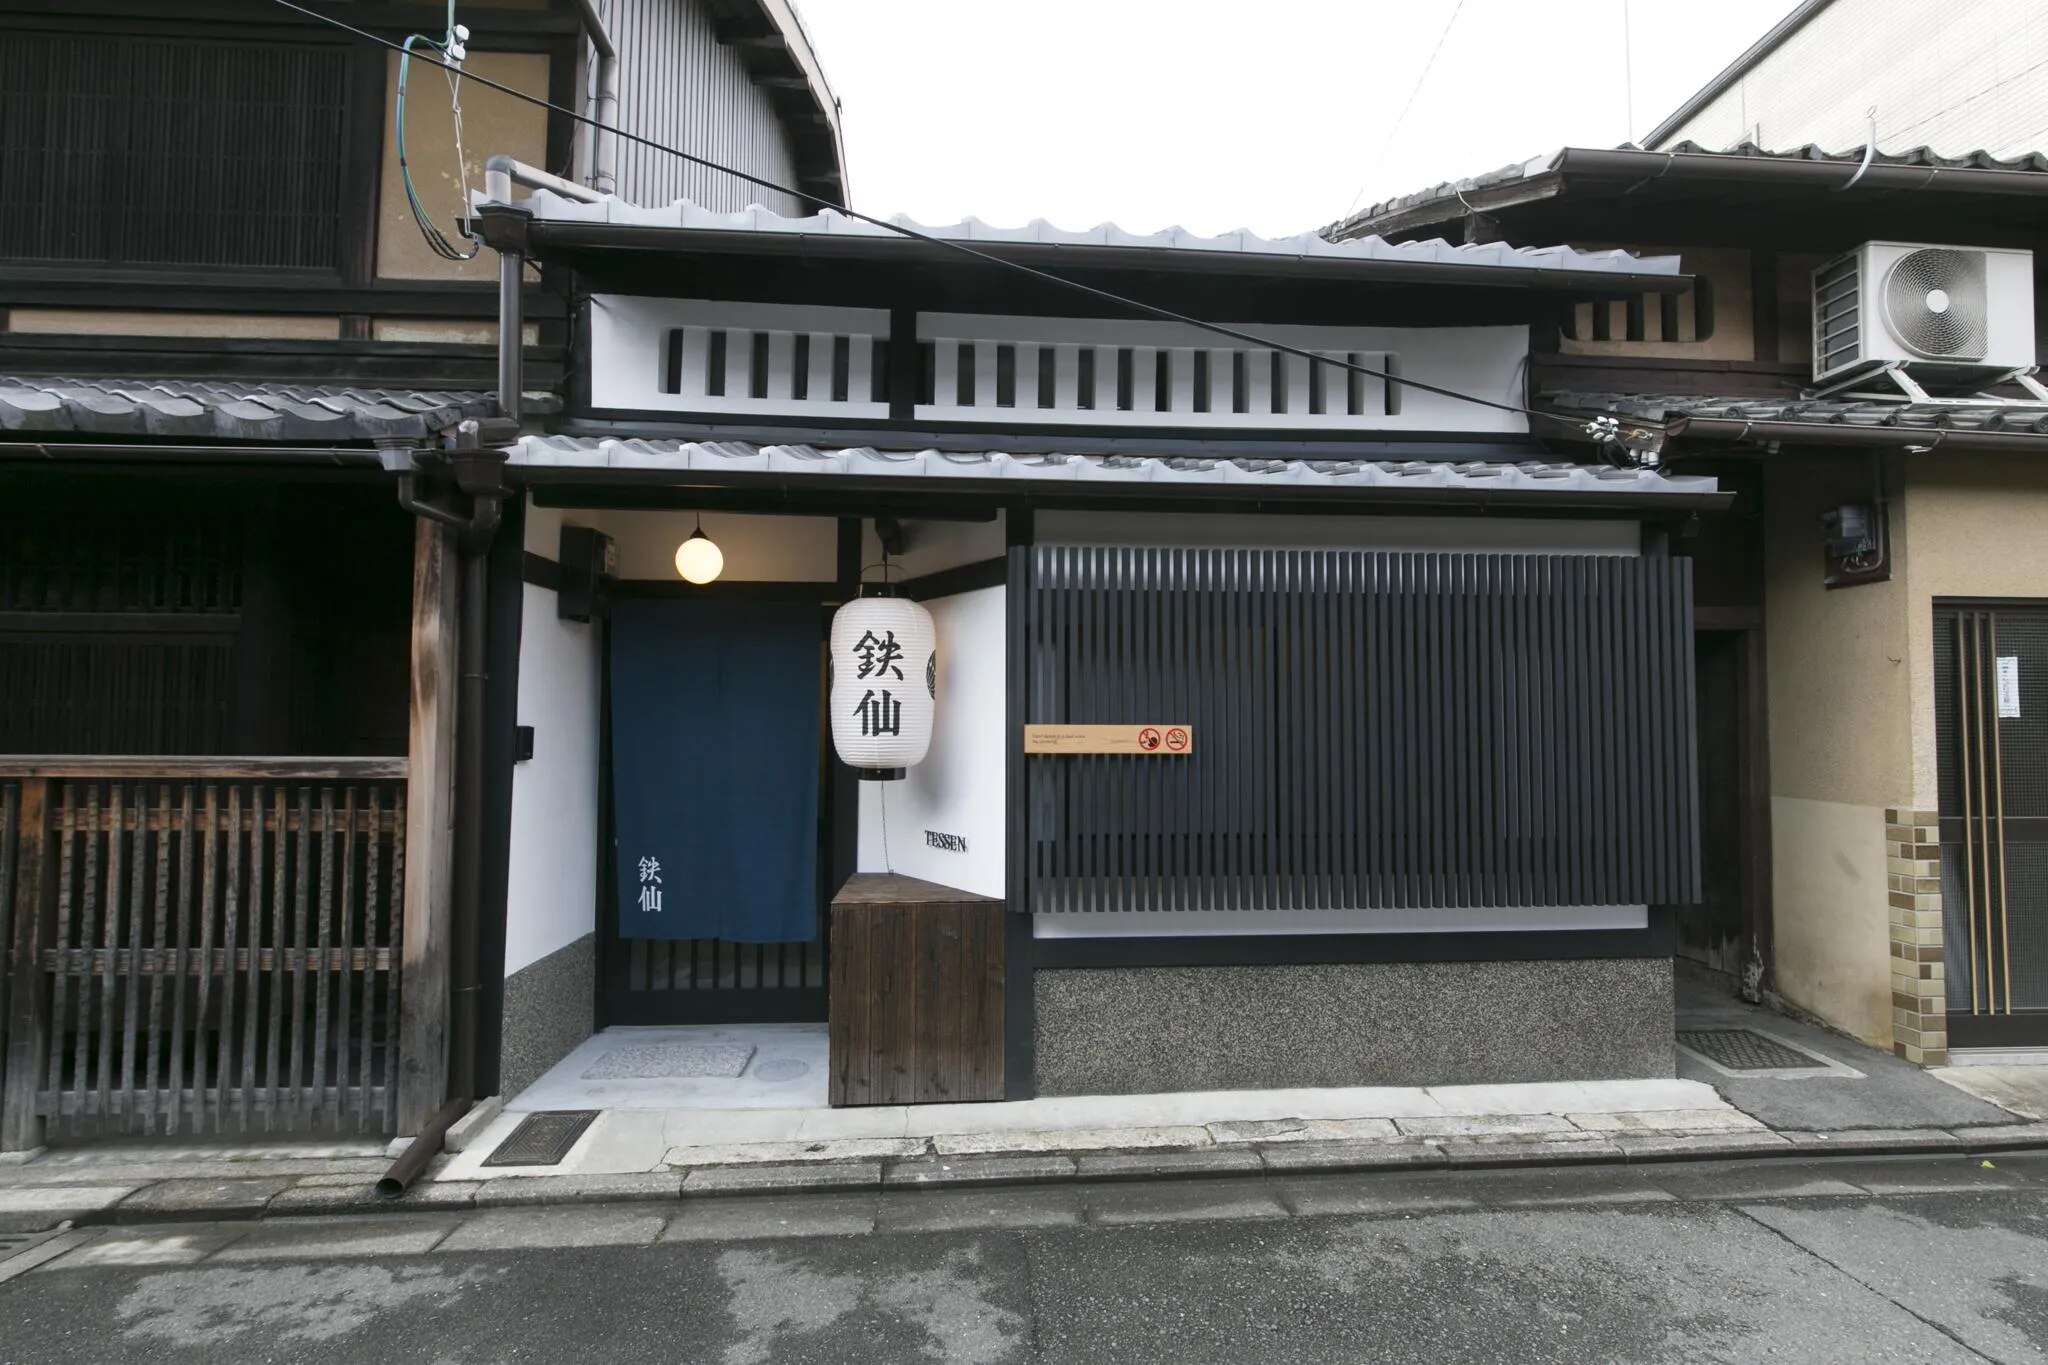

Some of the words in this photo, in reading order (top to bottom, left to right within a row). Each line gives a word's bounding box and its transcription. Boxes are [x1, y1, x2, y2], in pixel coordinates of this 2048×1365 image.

[853, 629, 905, 737] 鉄仙
[924, 829, 968, 853] TESSEN
[638, 855, 663, 912] 鉄仙
